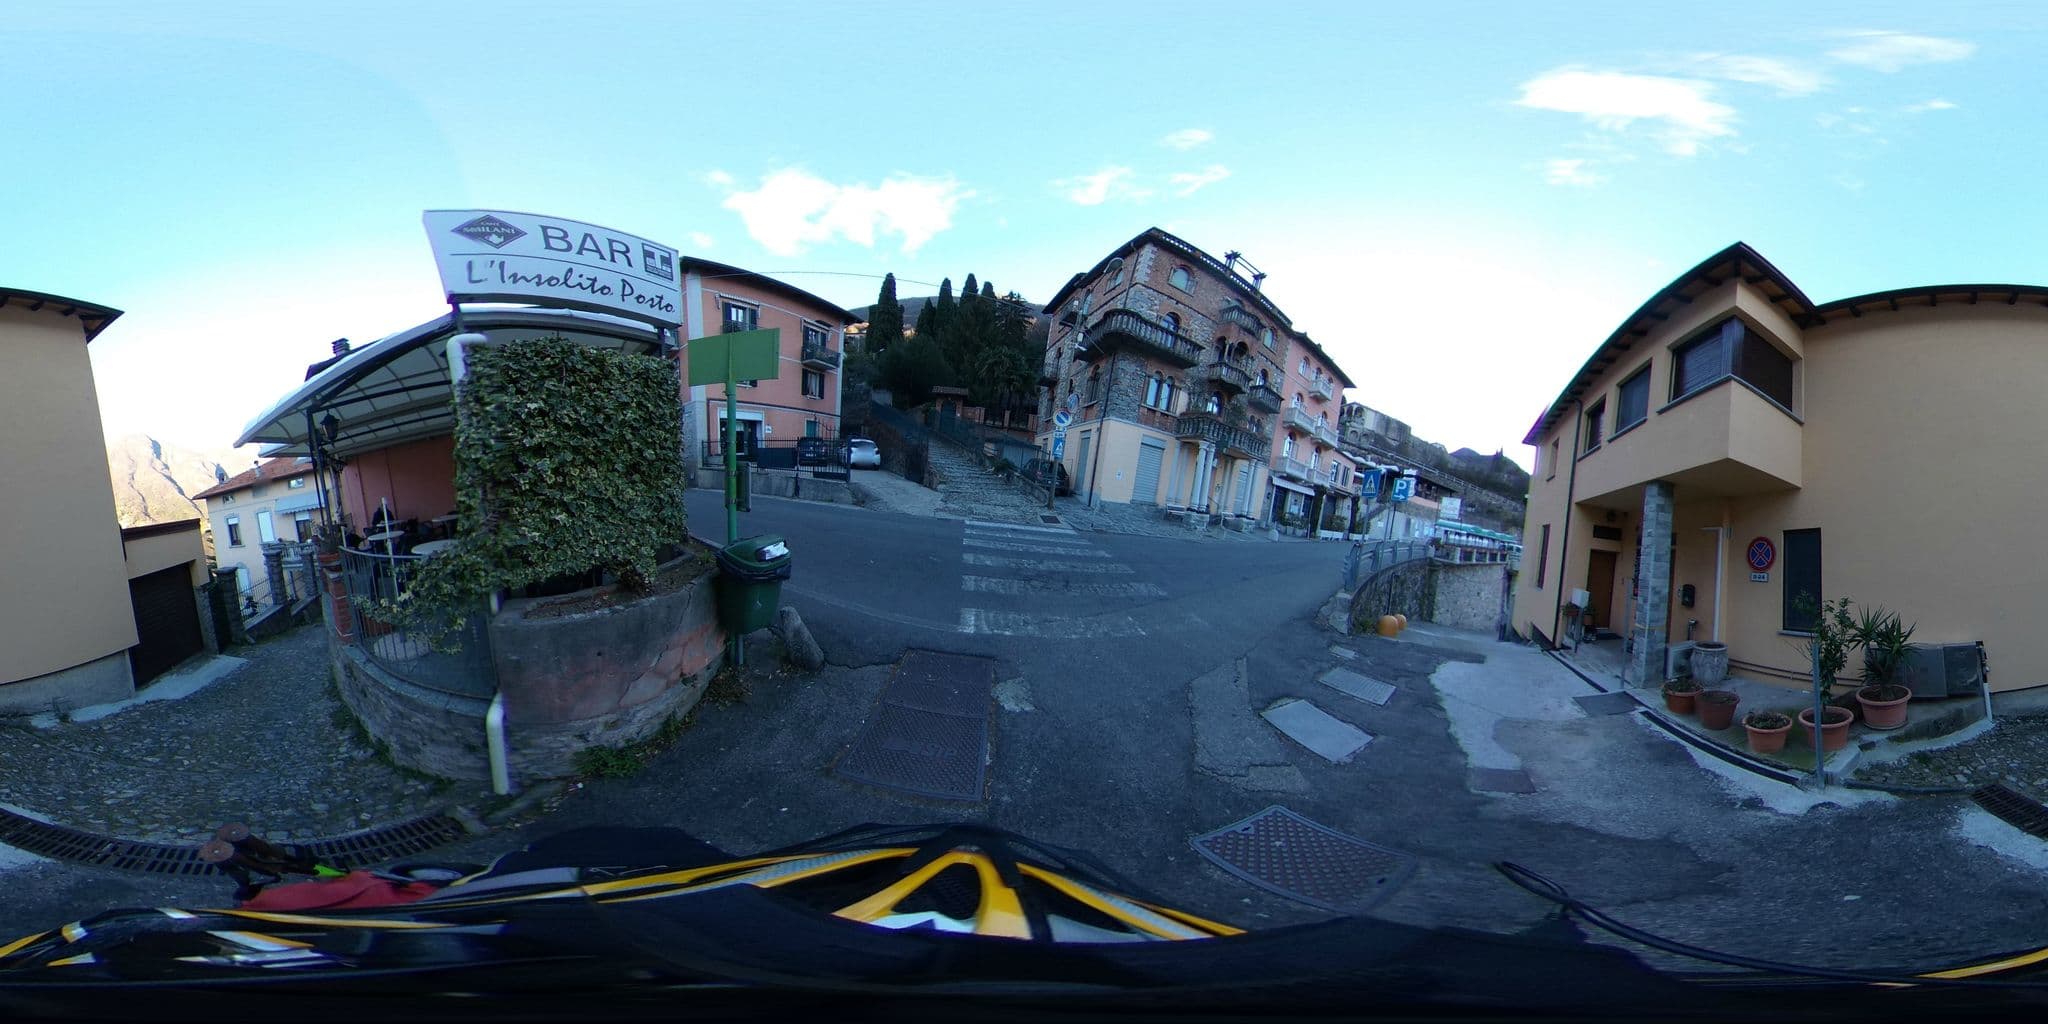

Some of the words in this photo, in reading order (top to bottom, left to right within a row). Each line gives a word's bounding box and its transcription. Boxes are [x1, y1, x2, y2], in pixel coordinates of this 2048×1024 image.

[539, 225, 634, 268] BAR
[466, 260, 613, 296] L'Insolito
[621, 278, 675, 313] Posto
[1395, 480, 1407, 494] P
